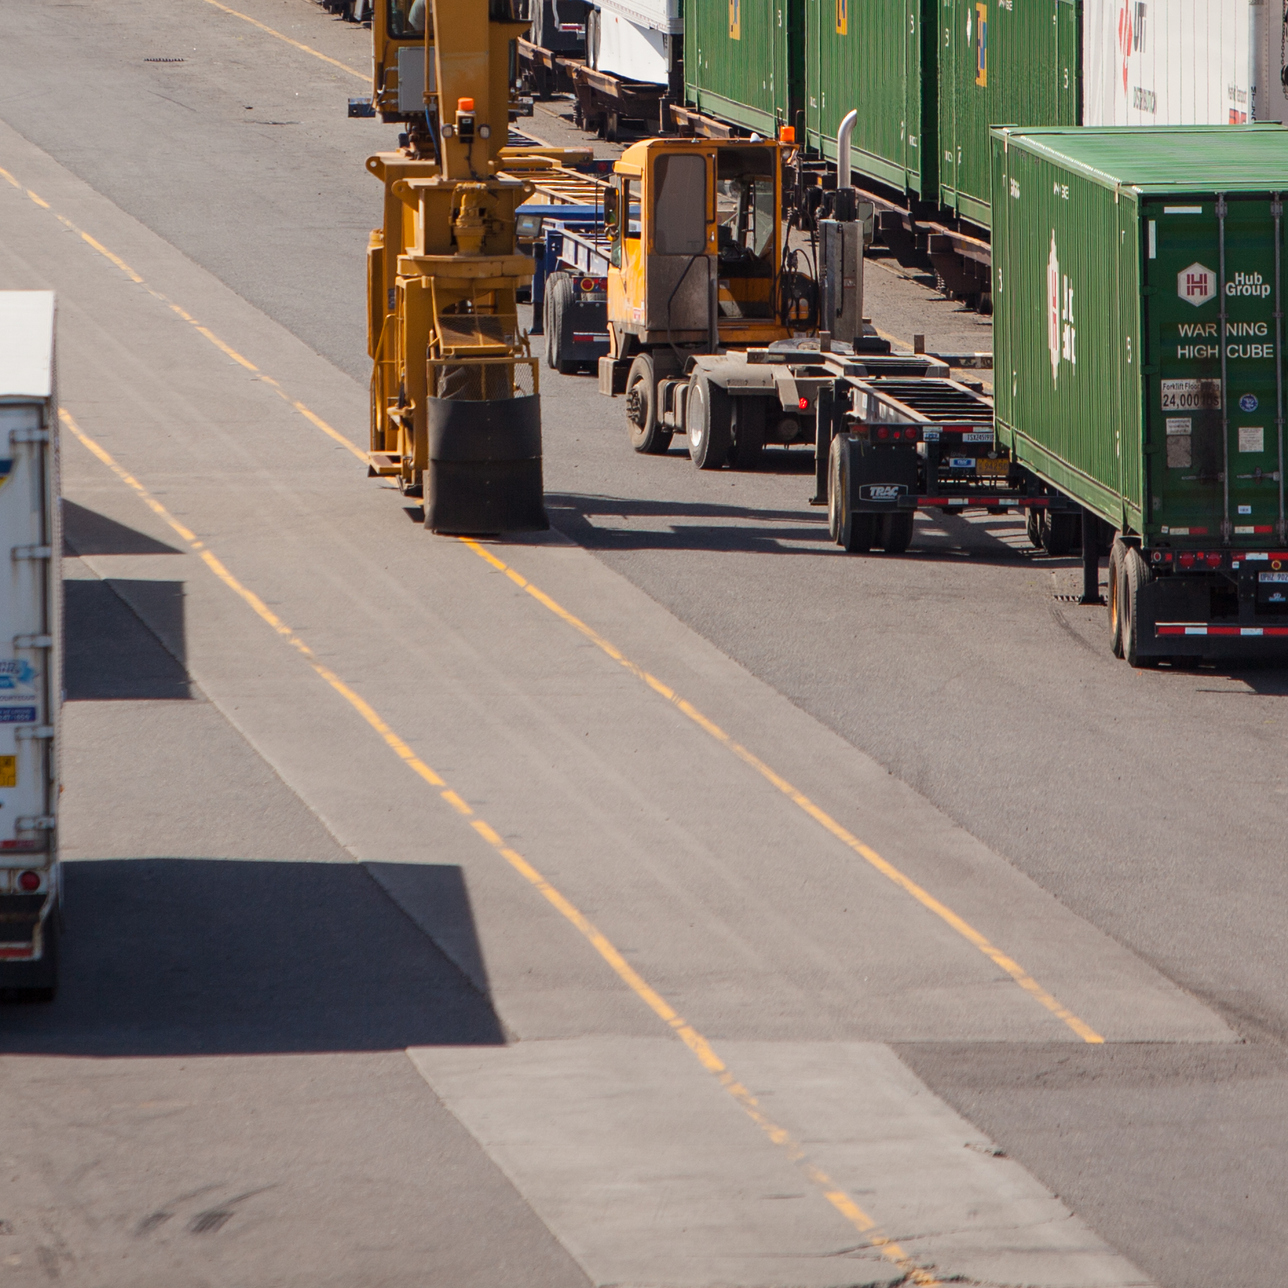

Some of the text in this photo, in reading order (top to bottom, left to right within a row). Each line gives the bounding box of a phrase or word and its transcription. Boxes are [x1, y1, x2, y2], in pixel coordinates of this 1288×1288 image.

[1235, 272, 1263, 285] Hub
[1225, 282, 1271, 298] Group
[1178, 322, 1268, 337] WARNING
[1178, 344, 1274, 359] HIGH CUBE
[1163, 382, 1184, 391] Forklift
[1163, 393, 1200, 407] 24,000
[869, 486, 899, 495] TRAC
